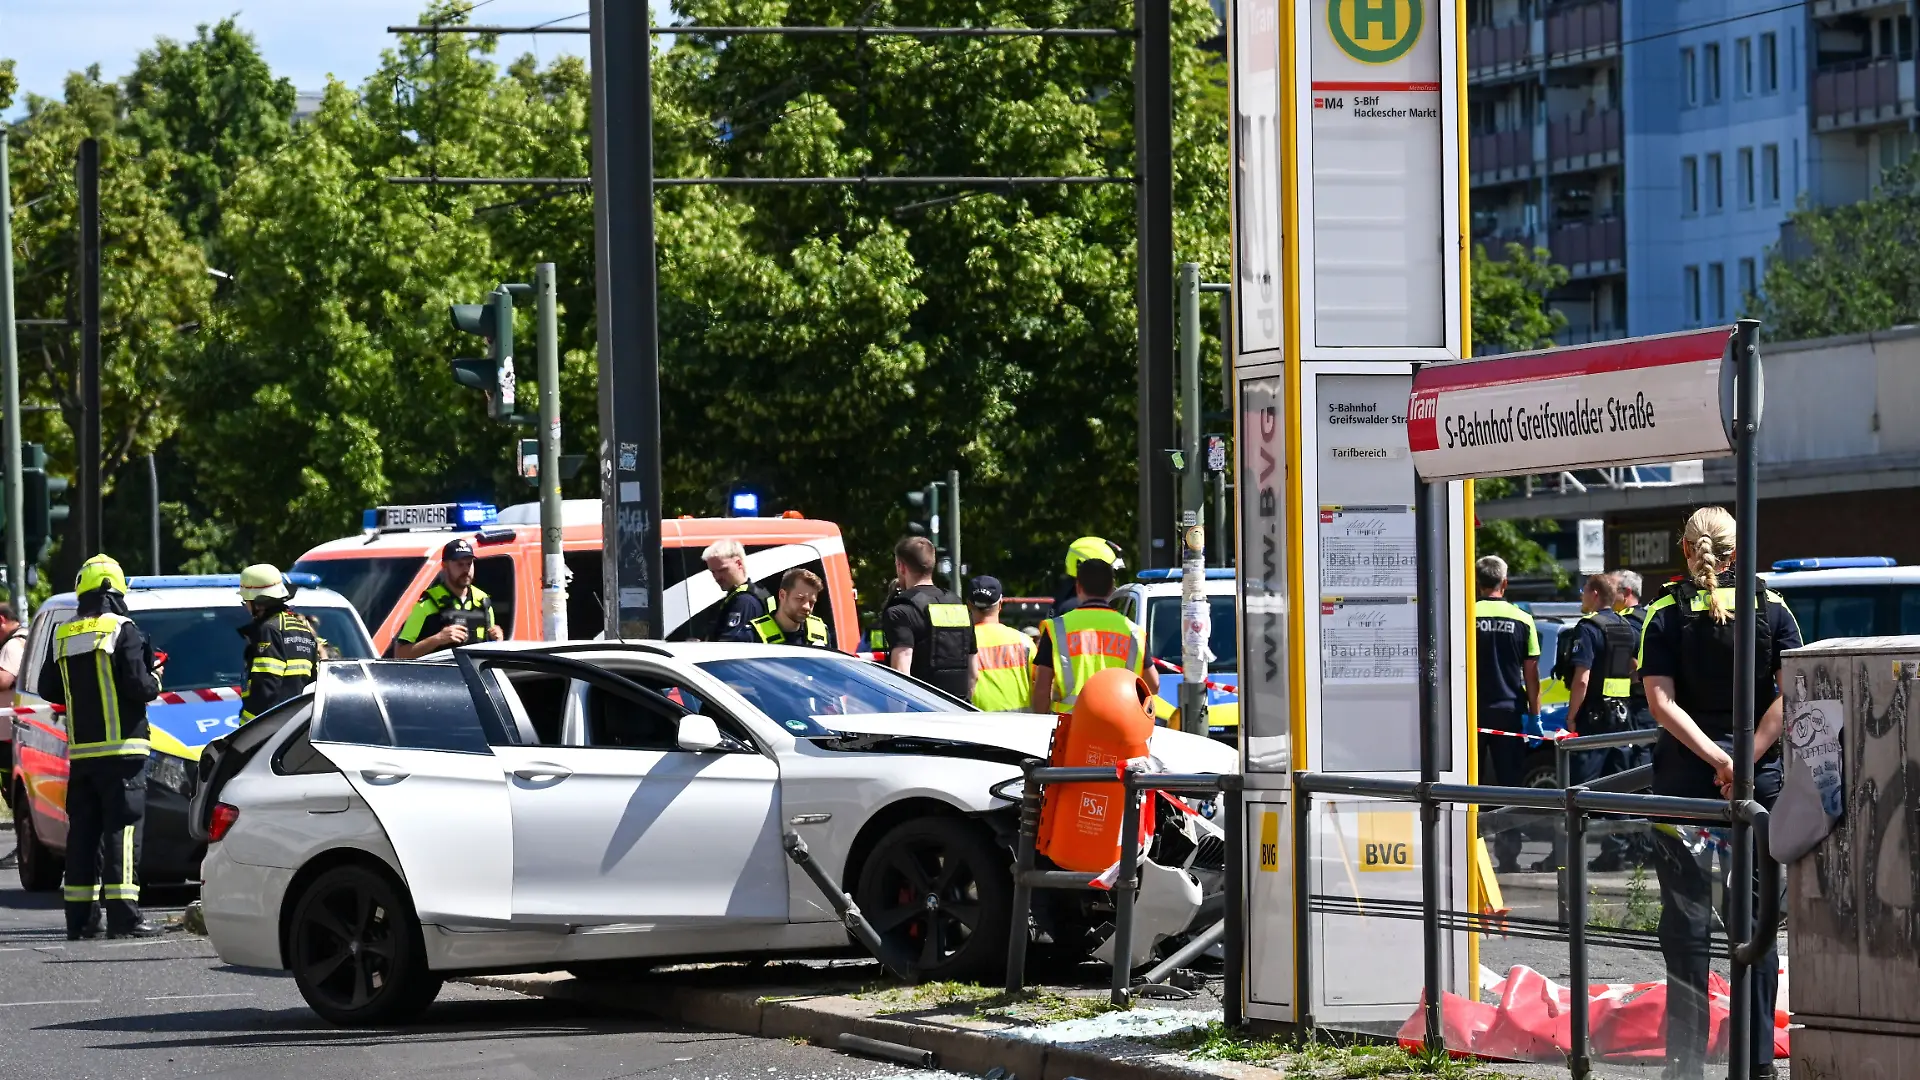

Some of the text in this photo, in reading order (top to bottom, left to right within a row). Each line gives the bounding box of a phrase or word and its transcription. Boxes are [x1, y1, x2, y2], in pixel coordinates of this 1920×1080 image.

[1355, 0, 1396, 40] H
[1325, 98, 1343, 109] M4
[1354, 96, 1379, 106] S-Bhf
[1354, 108, 1437, 118] Hackescher Markt
[1329, 403, 1377, 413] S-Bahnhof
[1409, 393, 1437, 420] Tram
[1329, 415, 1389, 425] Greifswalder
[1445, 391, 1656, 449] S-Bahnhof Greifswalder Straße
[1332, 448, 1387, 458] Tarifbereich
[387, 507, 446, 525] FEUERWEHR
[1070, 632, 1130, 655] POLIZEI
[1331, 643, 1417, 659] Baufahrplan
[1083, 797, 1103, 816] BSR
[1262, 843, 1276, 866] BVG
[1365, 843, 1407, 866] BVG
